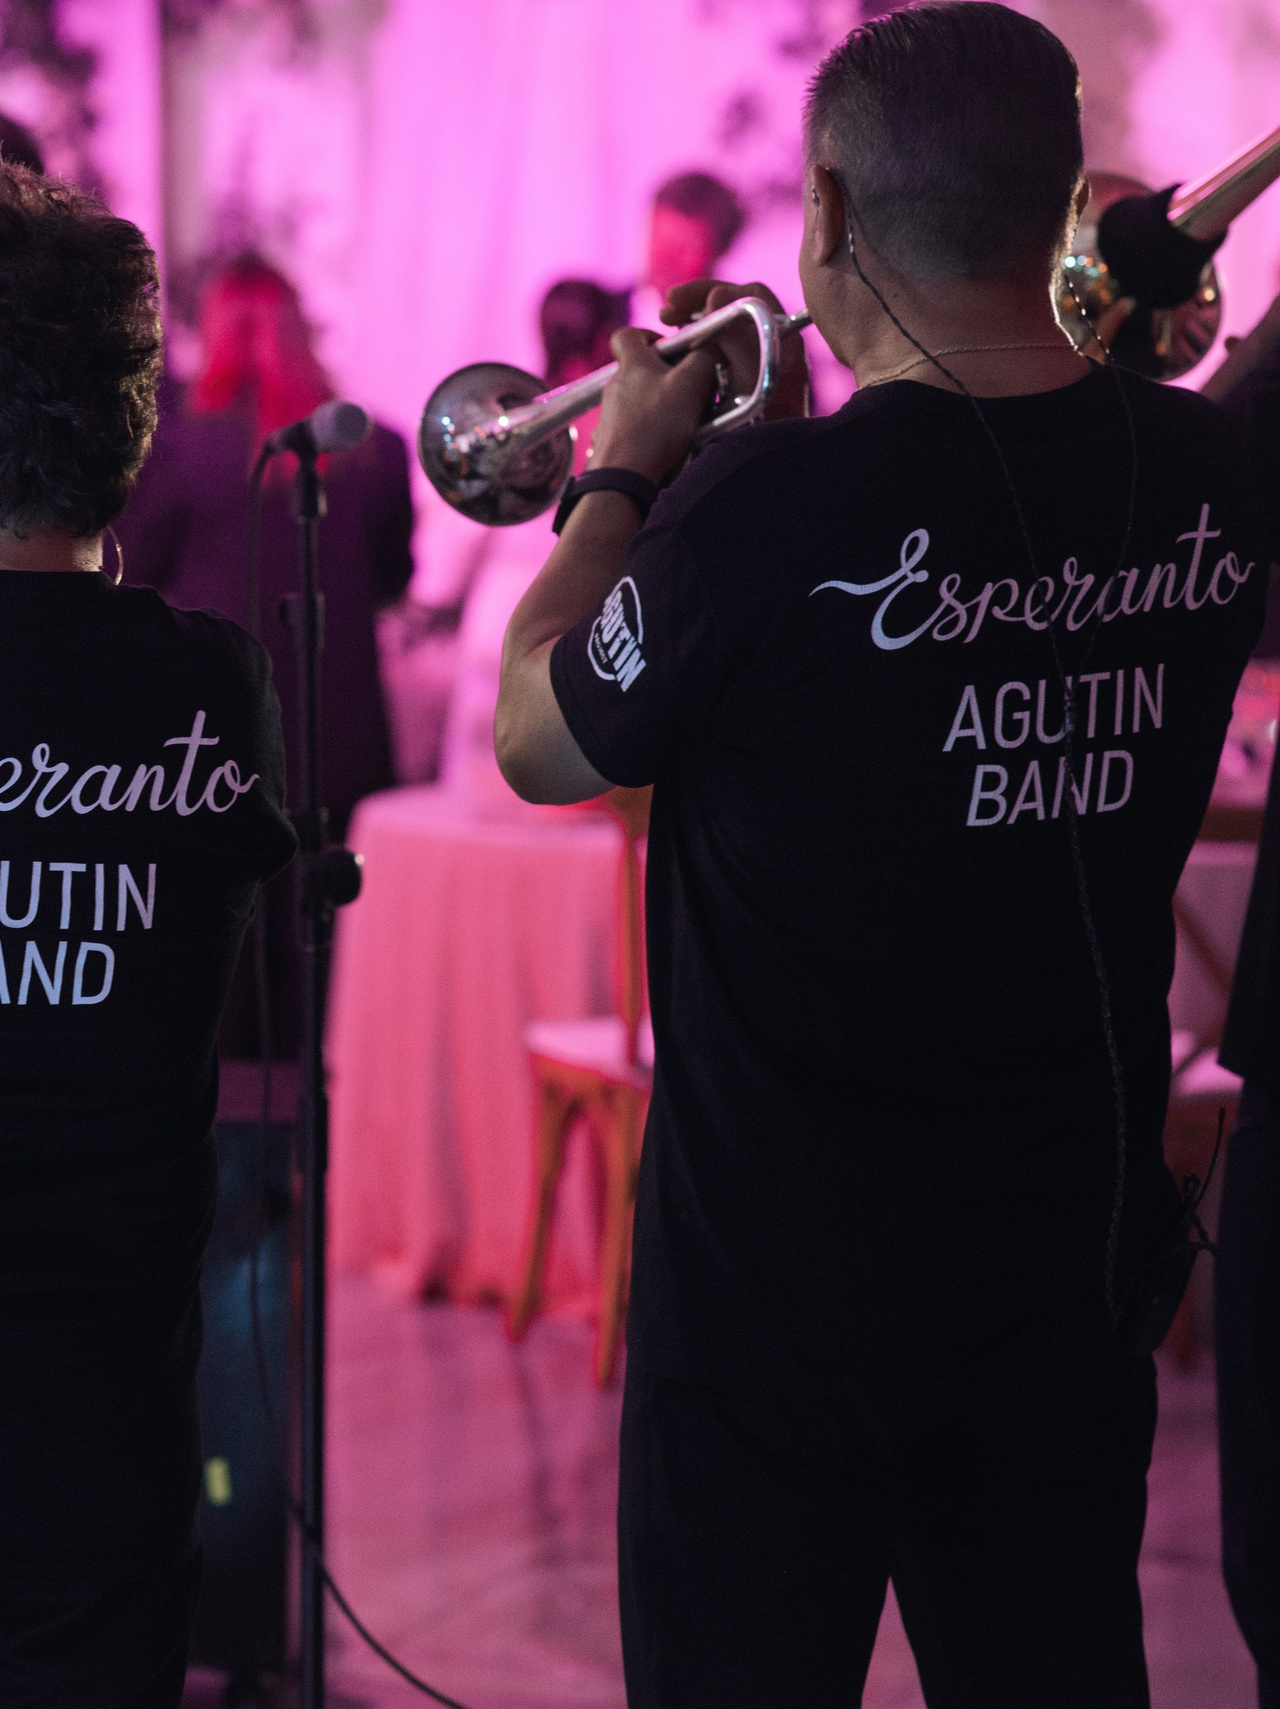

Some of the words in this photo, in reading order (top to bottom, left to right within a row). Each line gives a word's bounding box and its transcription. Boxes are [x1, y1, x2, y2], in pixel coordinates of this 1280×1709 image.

[809, 503, 1256, 651] Esperanto
[941, 662, 1166, 752] AGUTIN
[965, 748, 1136, 828] BAND
